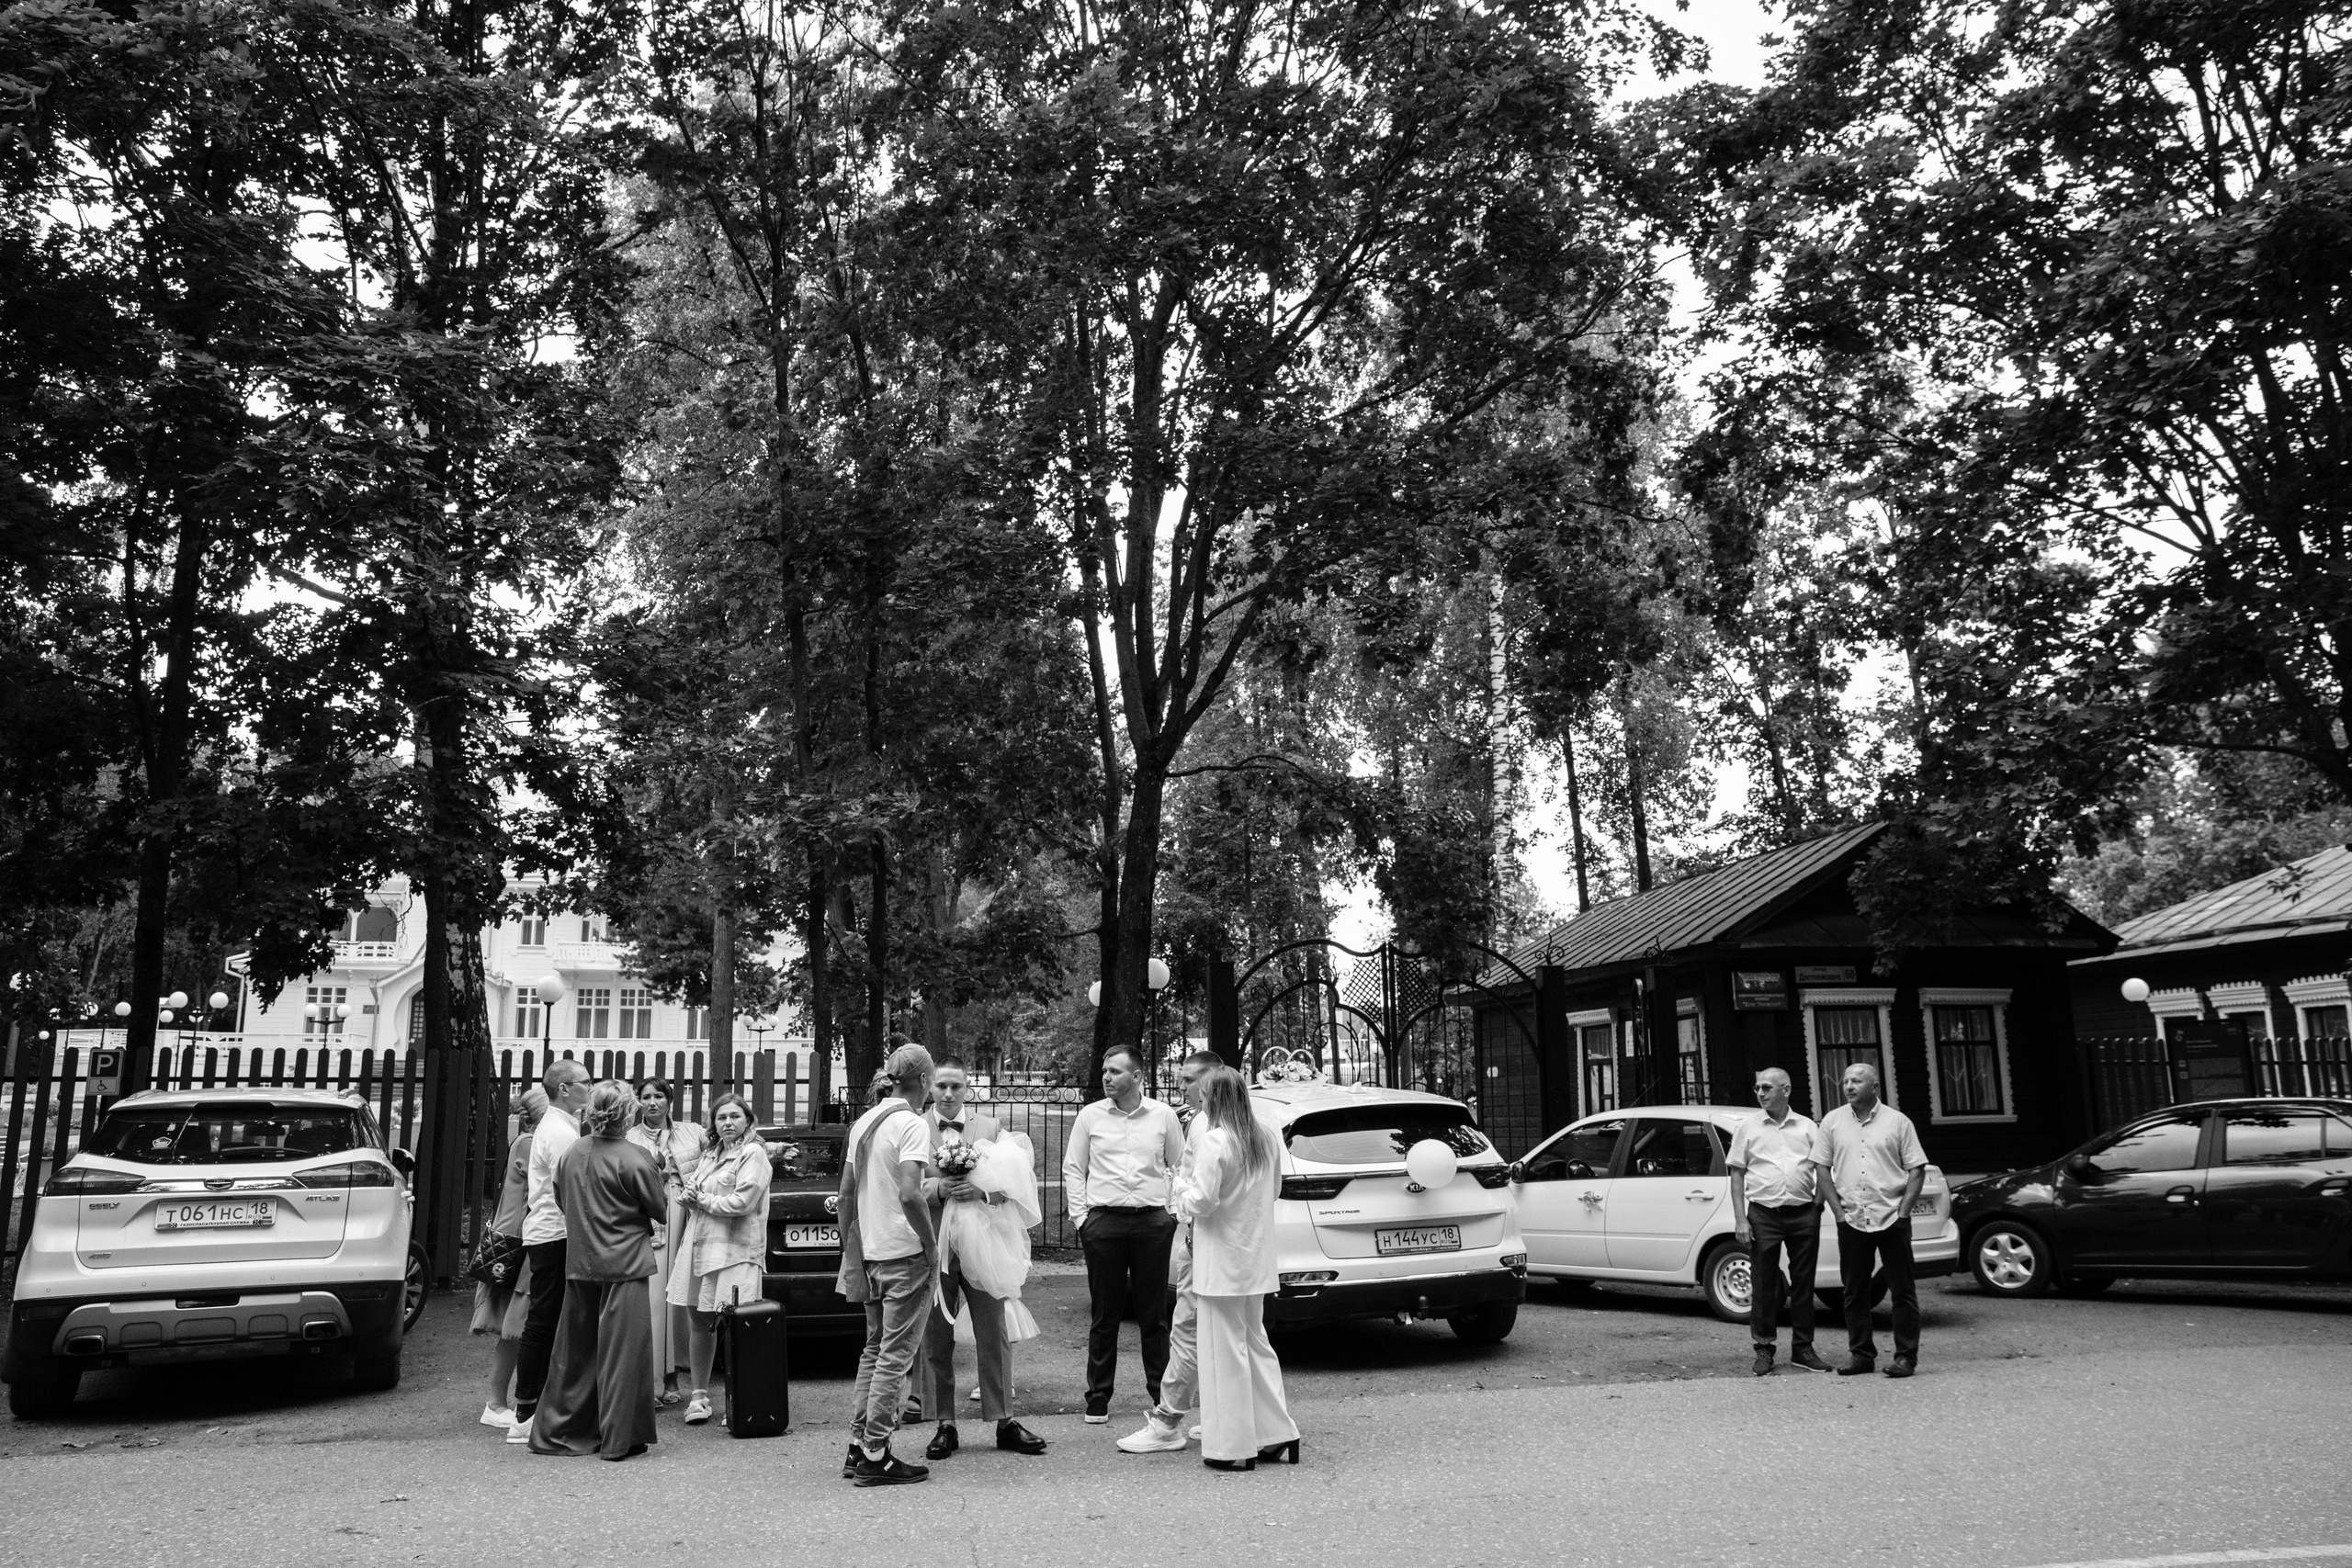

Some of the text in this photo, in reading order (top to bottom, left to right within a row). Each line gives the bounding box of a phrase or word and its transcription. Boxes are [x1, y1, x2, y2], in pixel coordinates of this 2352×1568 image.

[1844, 969, 1855, 979] 60
[96, 1054, 114, 1075] P
[251, 1201, 268, 1215] 18
[1441, 1227, 1454, 1239] 18
